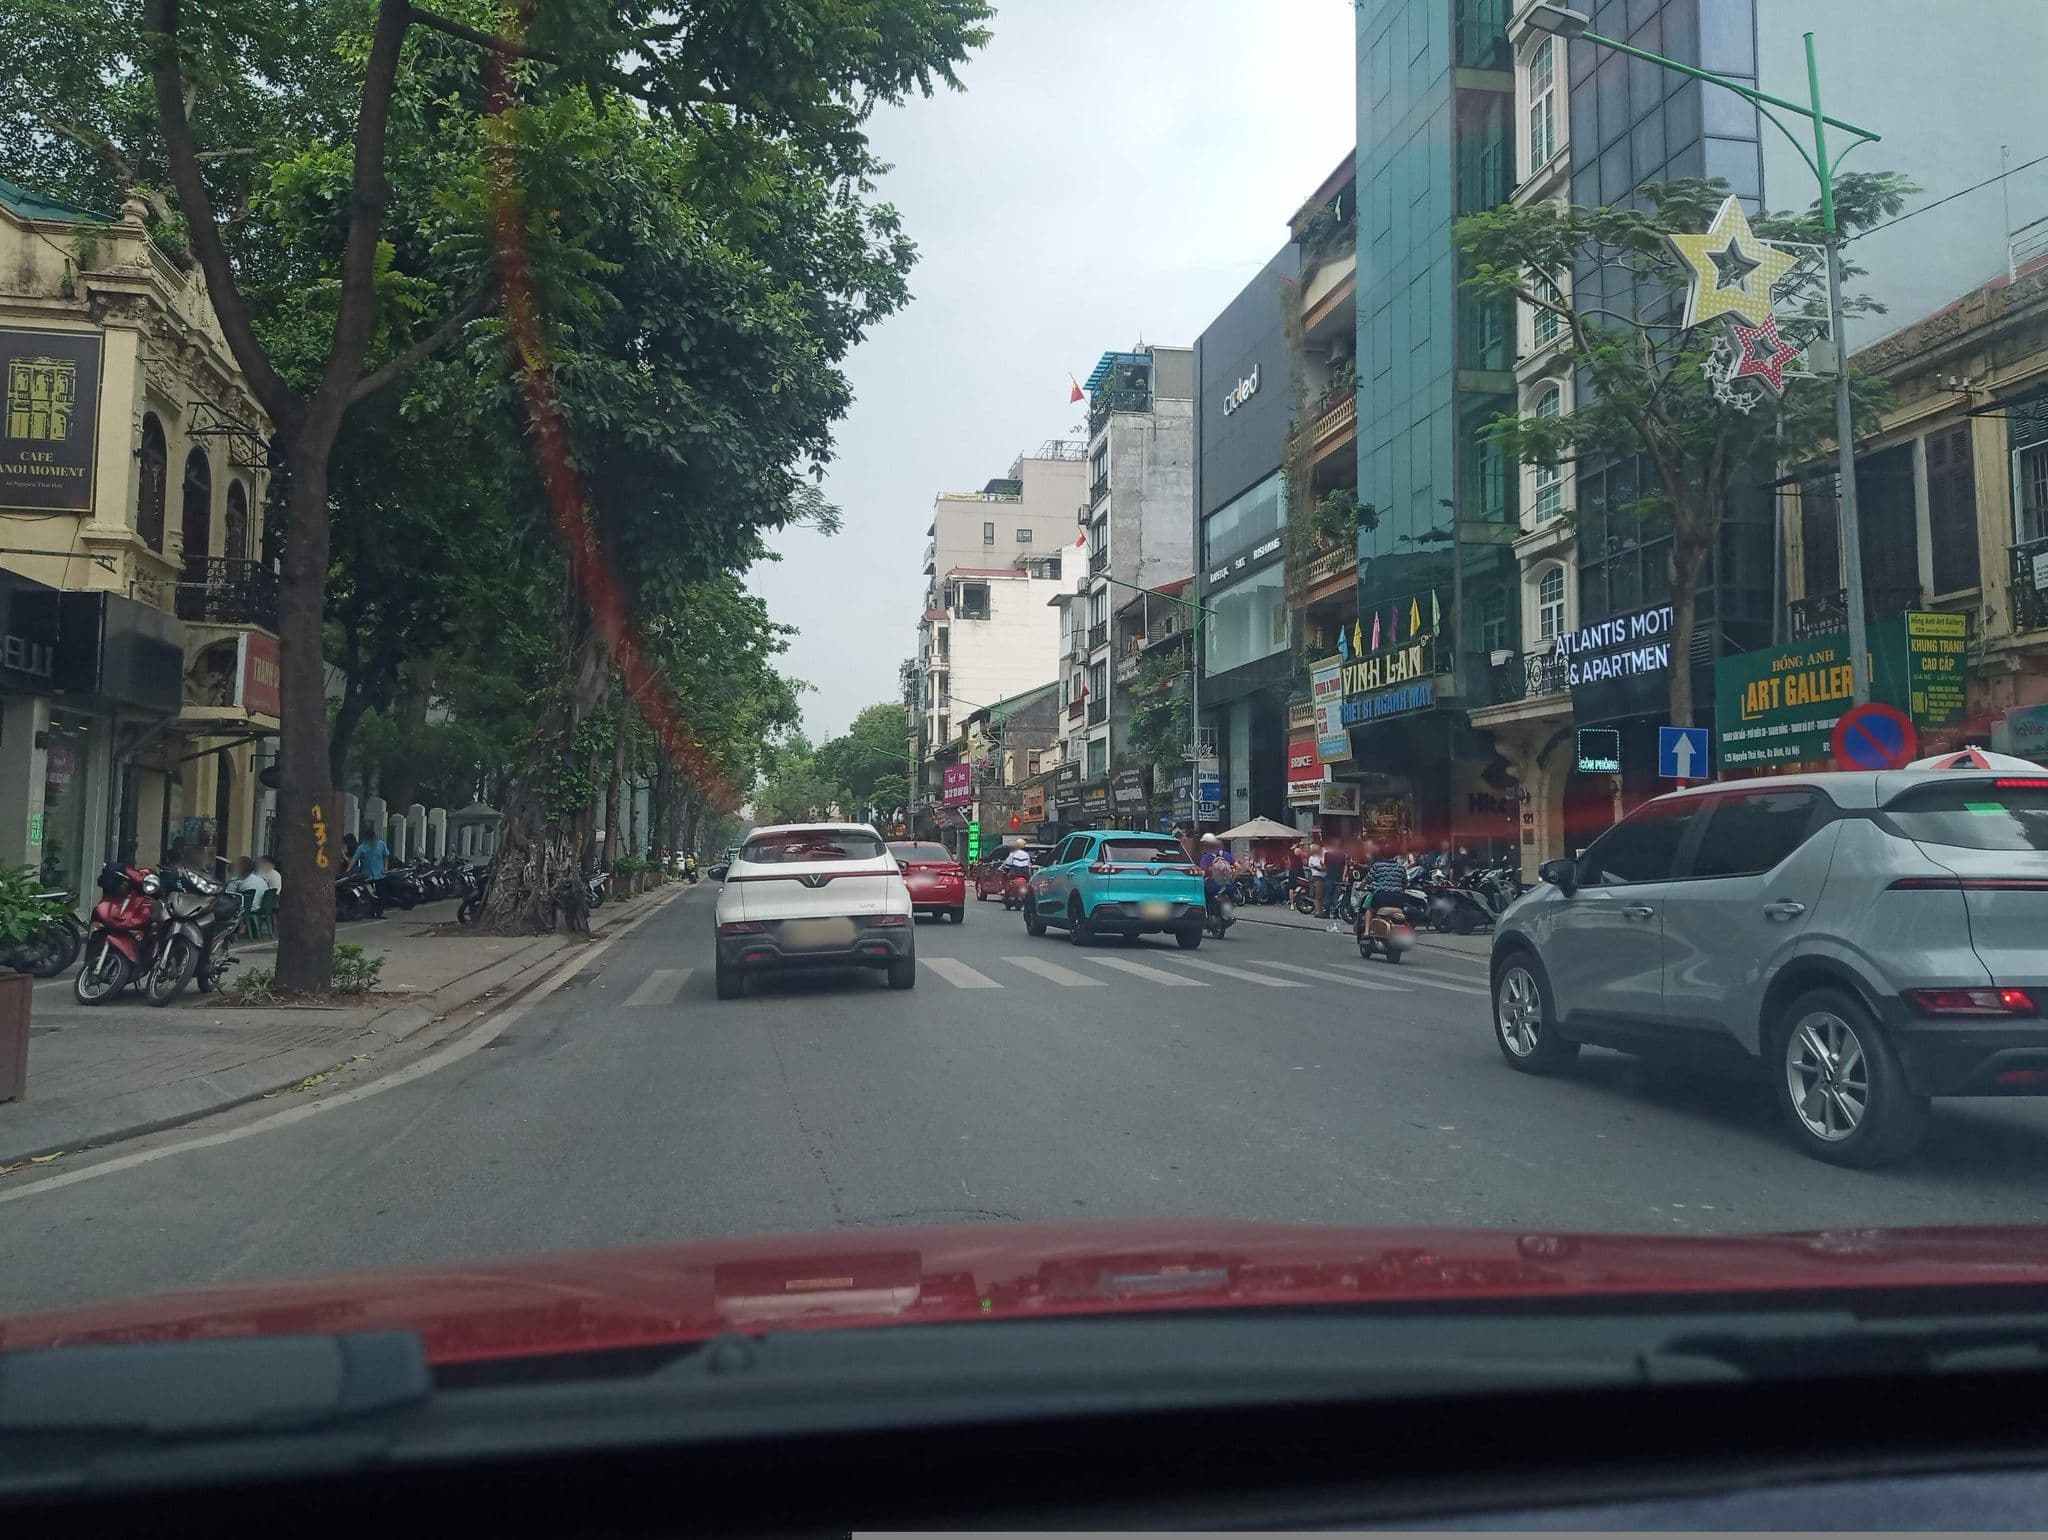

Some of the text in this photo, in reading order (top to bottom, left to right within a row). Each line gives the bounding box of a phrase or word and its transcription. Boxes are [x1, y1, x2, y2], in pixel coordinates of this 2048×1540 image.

[20, 451, 54, 462] CAFE
[0, 464, 86, 477] ANOI MOMENT
[1555, 606, 1674, 657] ATLANTIS MOT
[1911, 639, 1965, 653] KHUNG TRANH
[1386, 645, 1421, 685] LAN
[1569, 643, 1671, 685] & APARTMEN
[1807, 649, 1835, 665] ANH
[1921, 655, 1955, 671] CAO CẤP
[1746, 665, 1856, 713] ART GALLER
